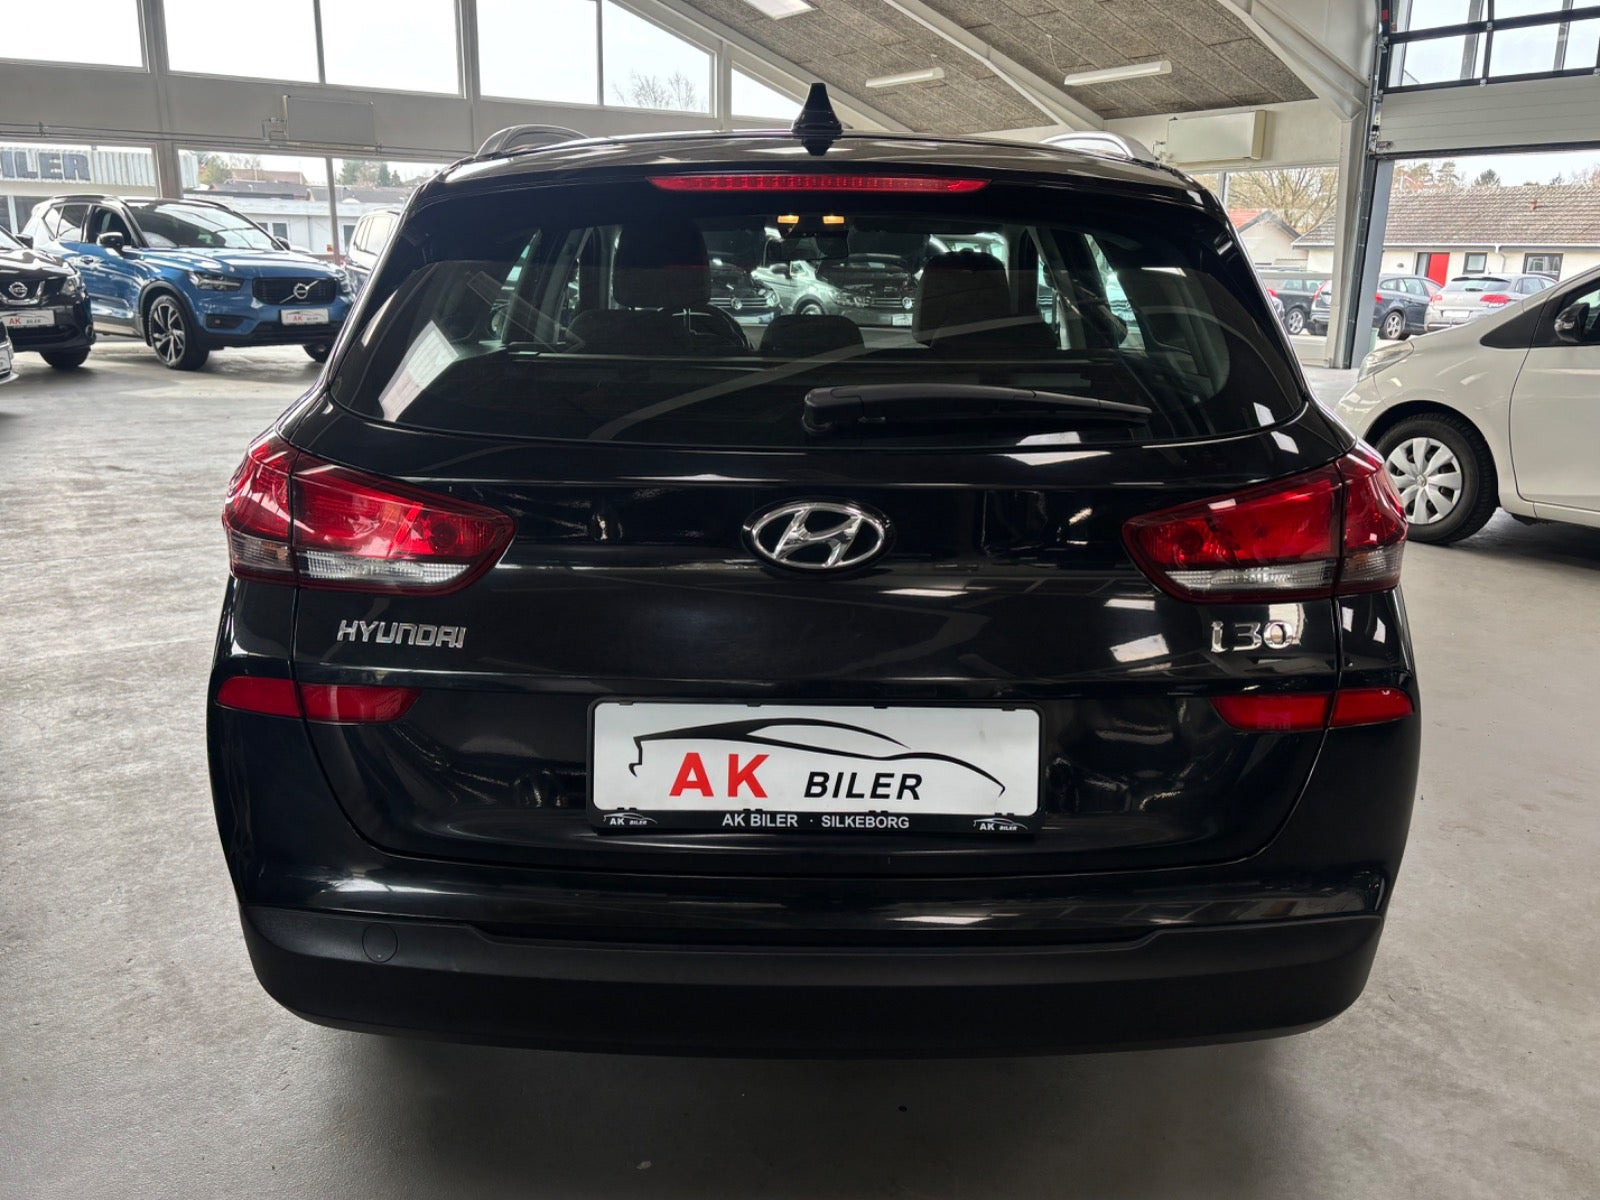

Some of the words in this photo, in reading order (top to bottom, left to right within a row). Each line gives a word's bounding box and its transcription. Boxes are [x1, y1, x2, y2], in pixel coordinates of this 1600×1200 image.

[0, 151, 91, 181] ILER
[336, 619, 467, 649] HYUNDAI
[669, 752, 770, 799] AK
[803, 771, 923, 801] BILER
[609, 817, 625, 826] AK
[721, 813, 746, 827] AK
[750, 814, 799, 828] BILER
[820, 815, 910, 829] SILKEBORG
[979, 823, 995, 831] AK
